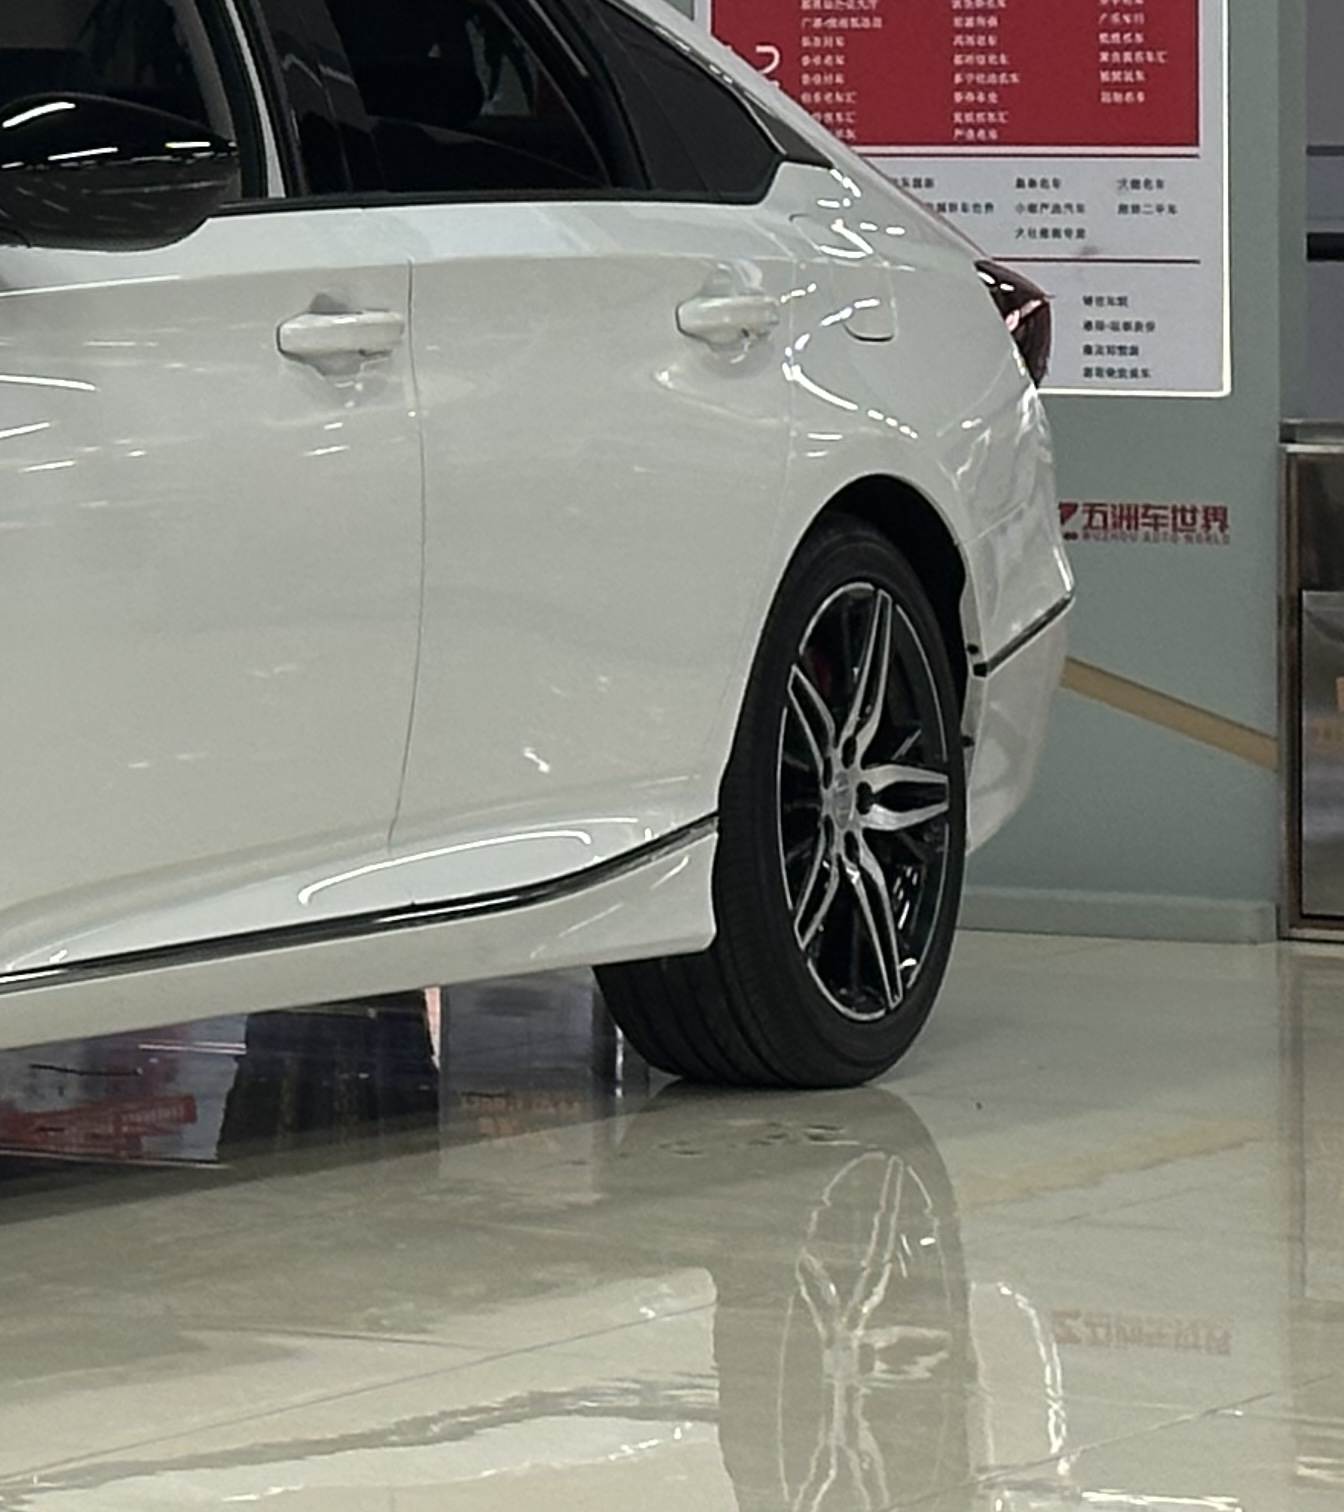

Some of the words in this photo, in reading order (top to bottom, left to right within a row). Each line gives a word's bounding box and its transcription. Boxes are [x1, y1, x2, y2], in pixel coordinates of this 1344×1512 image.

[1081, 502, 1229, 533] 五洲车世界
